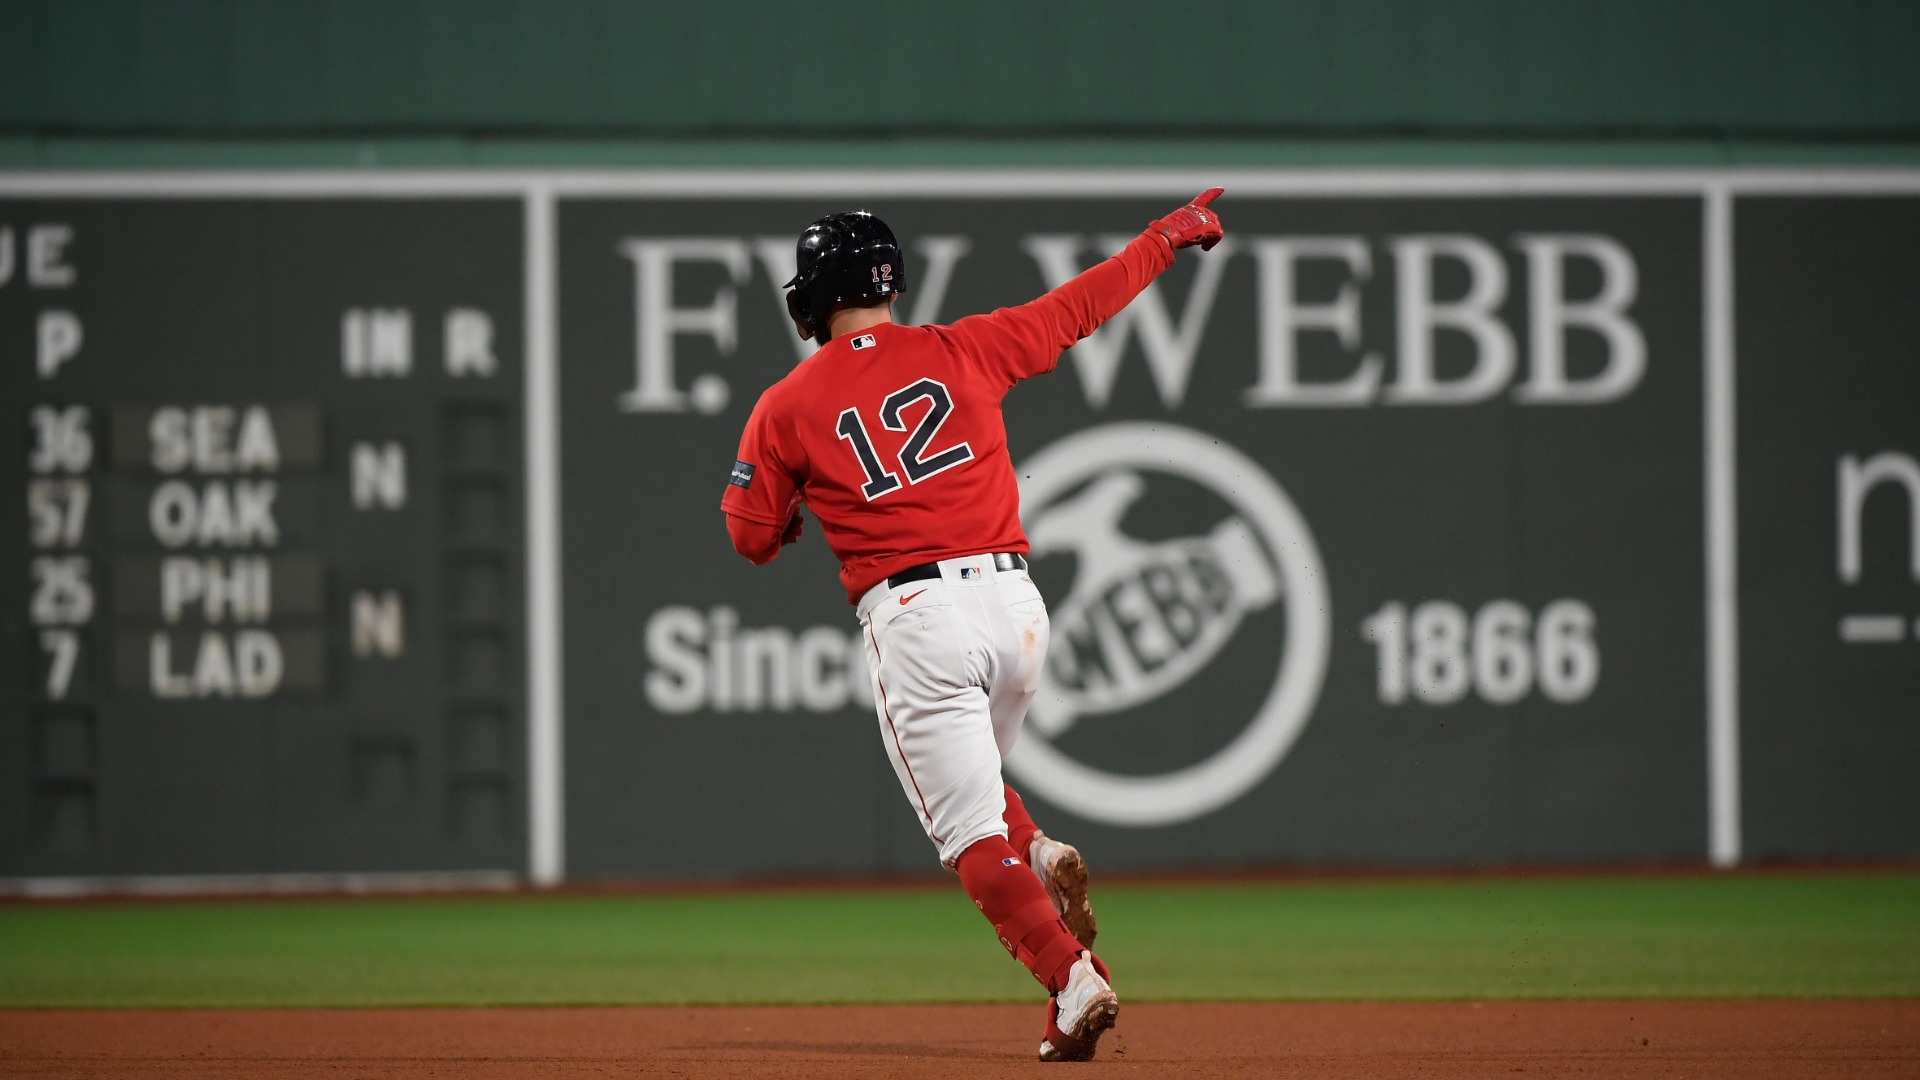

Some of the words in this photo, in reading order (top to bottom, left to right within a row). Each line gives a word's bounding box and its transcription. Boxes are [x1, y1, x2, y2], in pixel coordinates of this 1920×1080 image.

[871, 263, 893, 283] 12
[36, 311, 83, 376] P
[342, 309, 413, 375] IN
[444, 309, 496, 375] R
[1020, 234, 1647, 407] WEBB
[30, 405, 93, 474] 36
[149, 406, 280, 472] SEA
[836, 377, 975, 502] 12
[351, 443, 406, 509] N
[28, 480, 90, 547] 57
[149, 481, 278, 546] OAK
[31, 556, 95, 625] 25
[160, 557, 272, 622] PHI
[352, 592, 404, 657] N
[41, 629, 80, 699] 7
[149, 630, 284, 697] LAD
[1362, 600, 1600, 704] 1866
